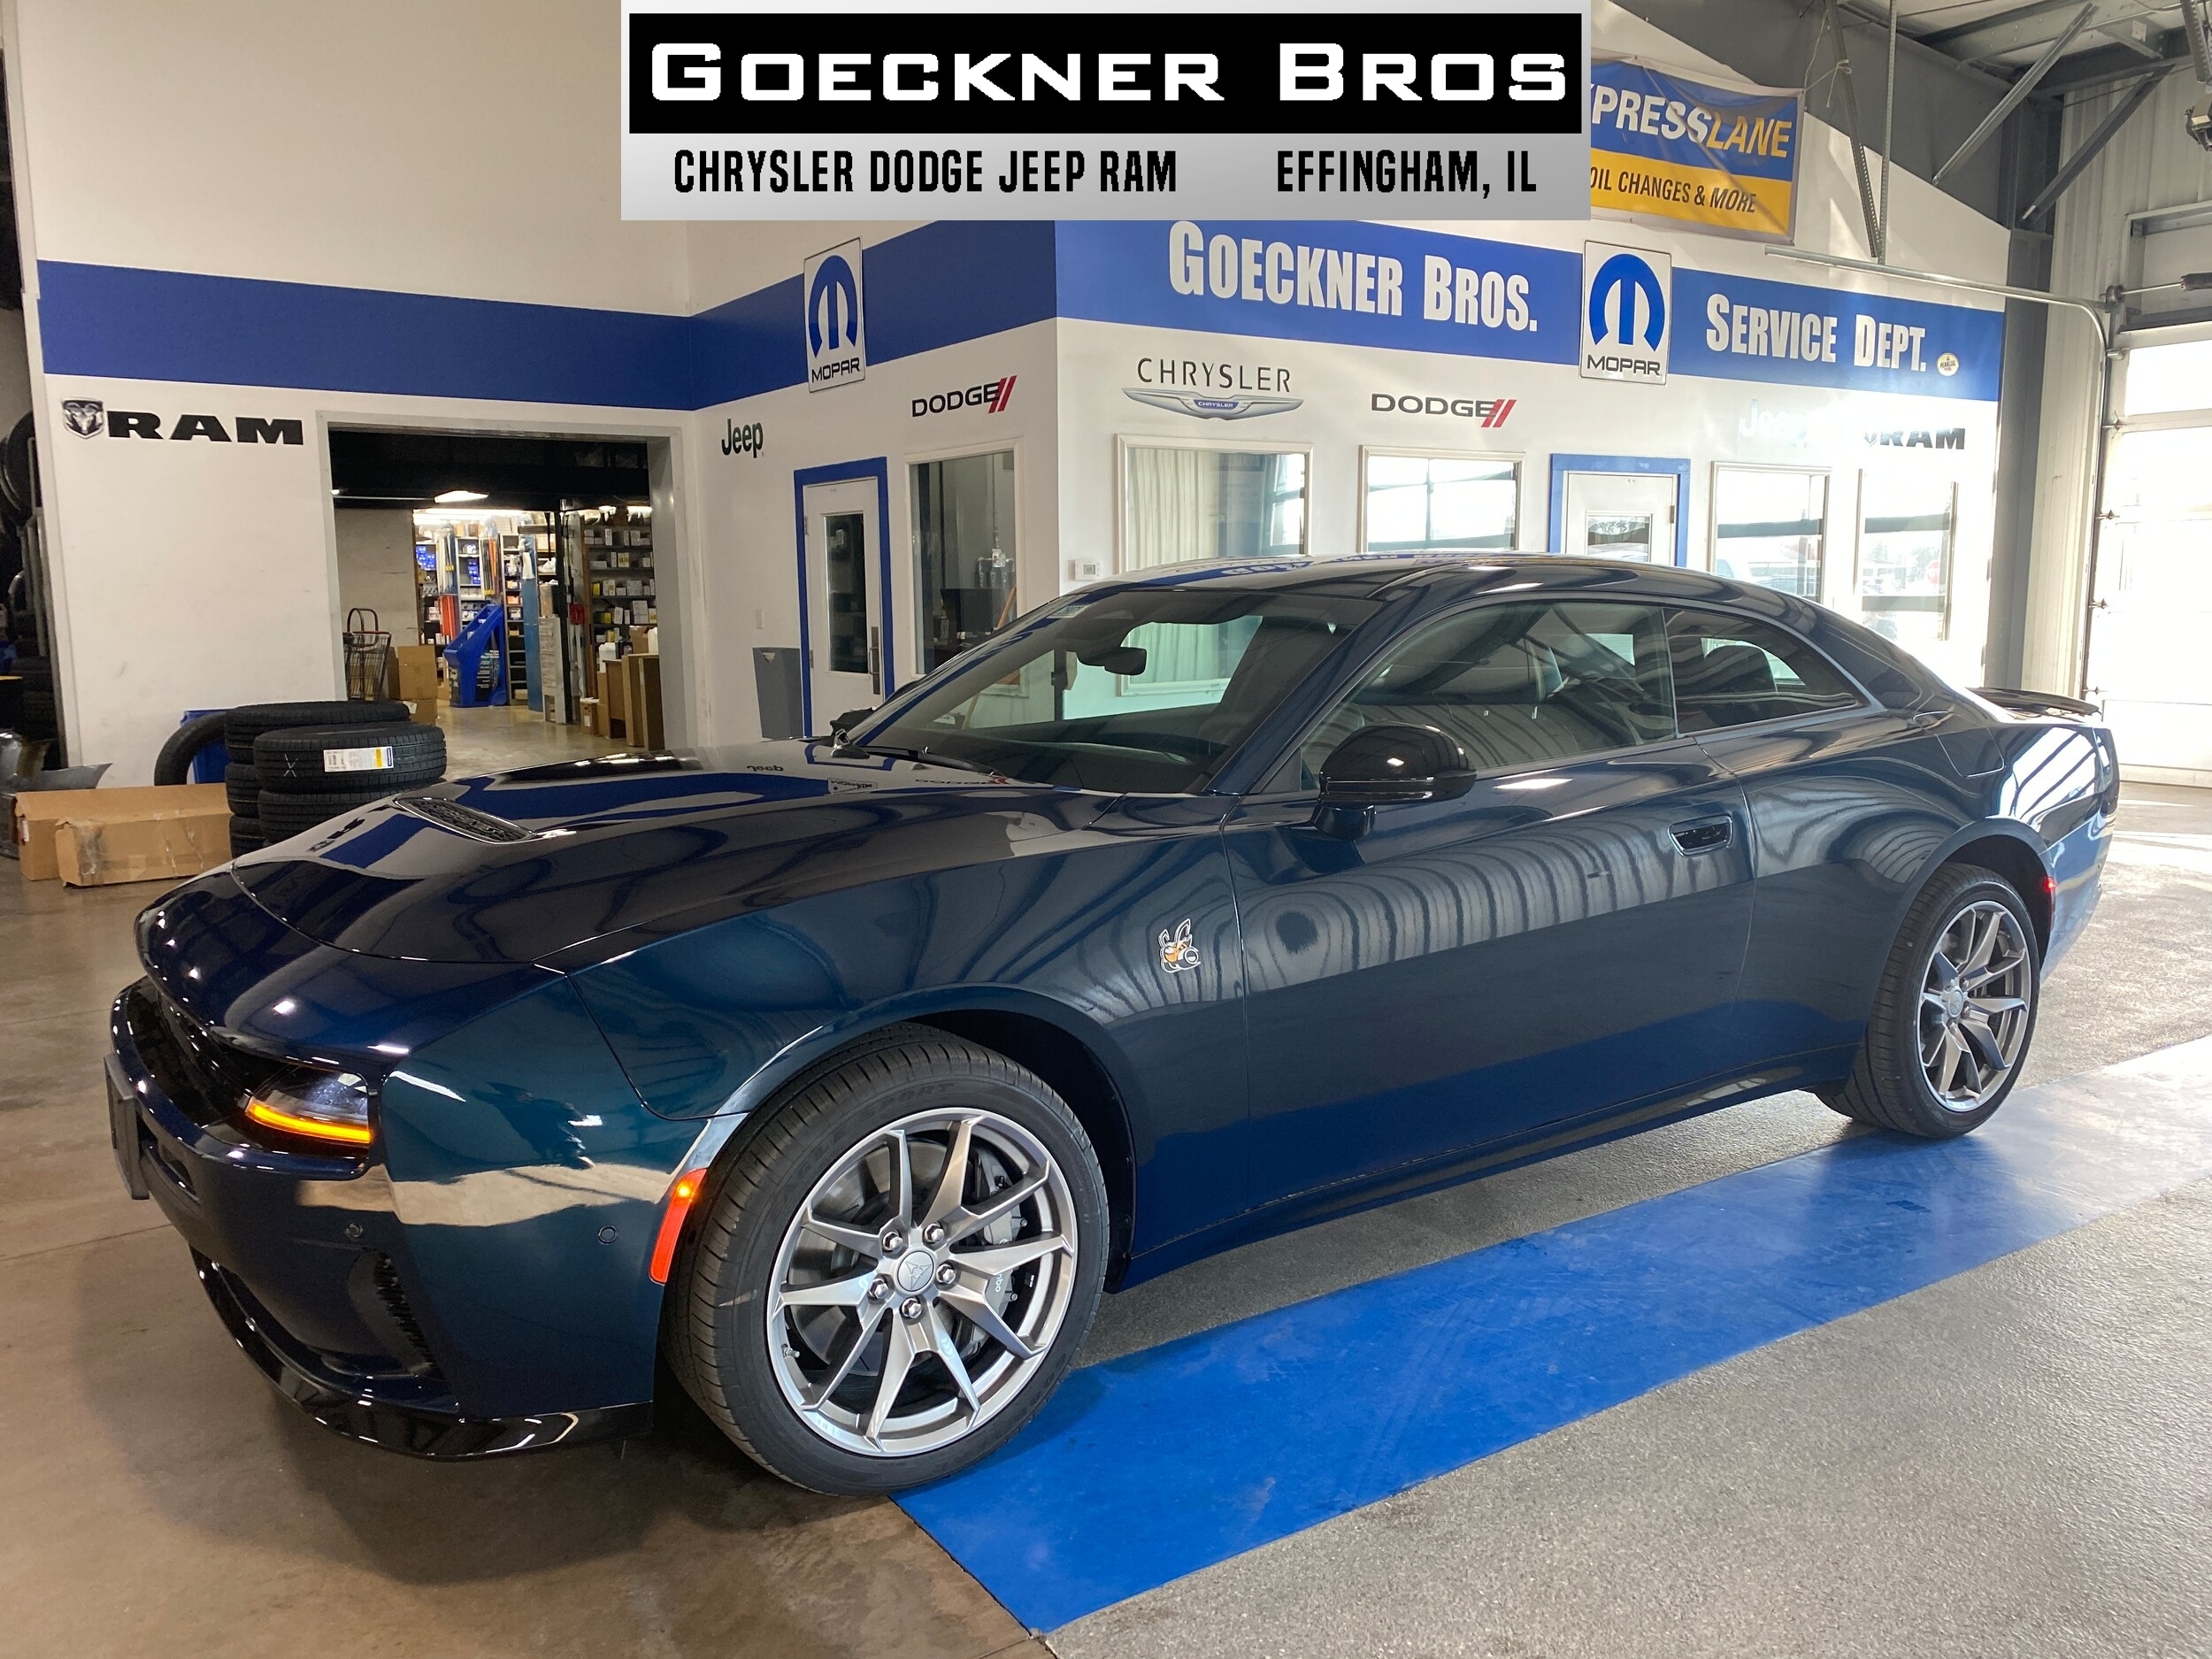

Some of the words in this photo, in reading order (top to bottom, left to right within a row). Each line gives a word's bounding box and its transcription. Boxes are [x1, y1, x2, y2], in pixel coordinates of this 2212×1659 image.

[1618, 171, 1690, 204] CHANGES
[1694, 185, 1705, 206] &
[1709, 187, 1757, 213] MORE
[1169, 220, 1403, 317] GOECKNER
[1424, 254, 1538, 332] BROS.
[1706, 294, 1838, 364] SERVICE
[1853, 314, 1926, 372] DEPT.
[811, 357, 861, 383] MOPAR
[1137, 357, 1291, 393] CHRYSLER
[1586, 355, 1661, 376] MOPAR
[911, 382, 1001, 418] DODGE
[1371, 393, 1497, 419] DODGE
[108, 411, 303, 446] RAM
[721, 418, 764, 458] Jeep
[1880, 427, 1966, 449] RAM
